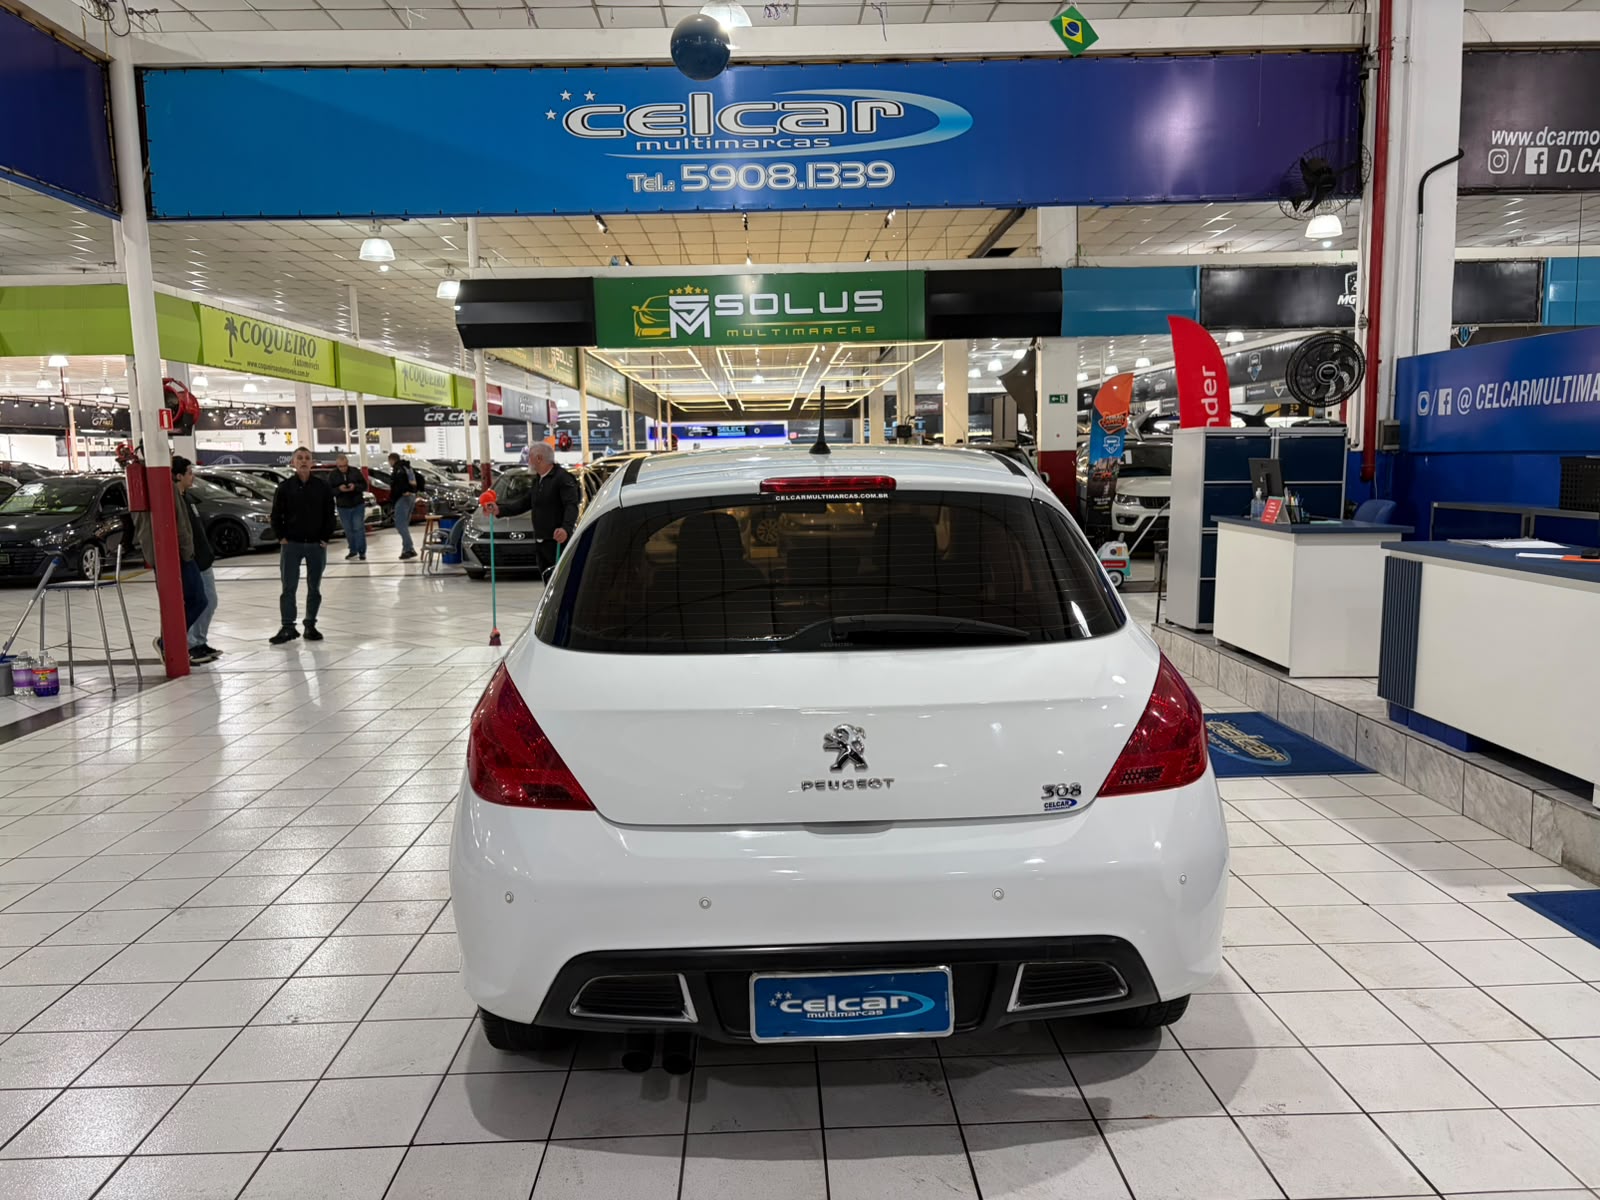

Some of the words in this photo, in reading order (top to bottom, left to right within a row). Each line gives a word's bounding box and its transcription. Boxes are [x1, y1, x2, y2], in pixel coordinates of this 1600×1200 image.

[563, 92, 904, 138] celcar
[636, 136, 831, 151] multimarcas
[1491, 126, 1600, 146] www.dcarmo
[628, 172, 675, 192] Tel.:
[681, 160, 895, 191] 5908.1339
[714, 290, 883, 316] SOLUS
[240, 321, 316, 358] COQUEIRO
[726, 326, 876, 337] MULTIMARCAS
[1201, 365, 1219, 427] nder
[1476, 373, 1600, 410] CELCARMULTIMA
[424, 412, 445, 422] CR
[776, 493, 889, 501] CELCARMULTIMARCAS.COM.BR
[801, 778, 895, 791] PEUGEOT
[1041, 782, 1081, 799] 308
[1044, 800, 1070, 808] CELCAR
[780, 995, 909, 1014] celcar
[807, 1009, 884, 1019] multimarcas
